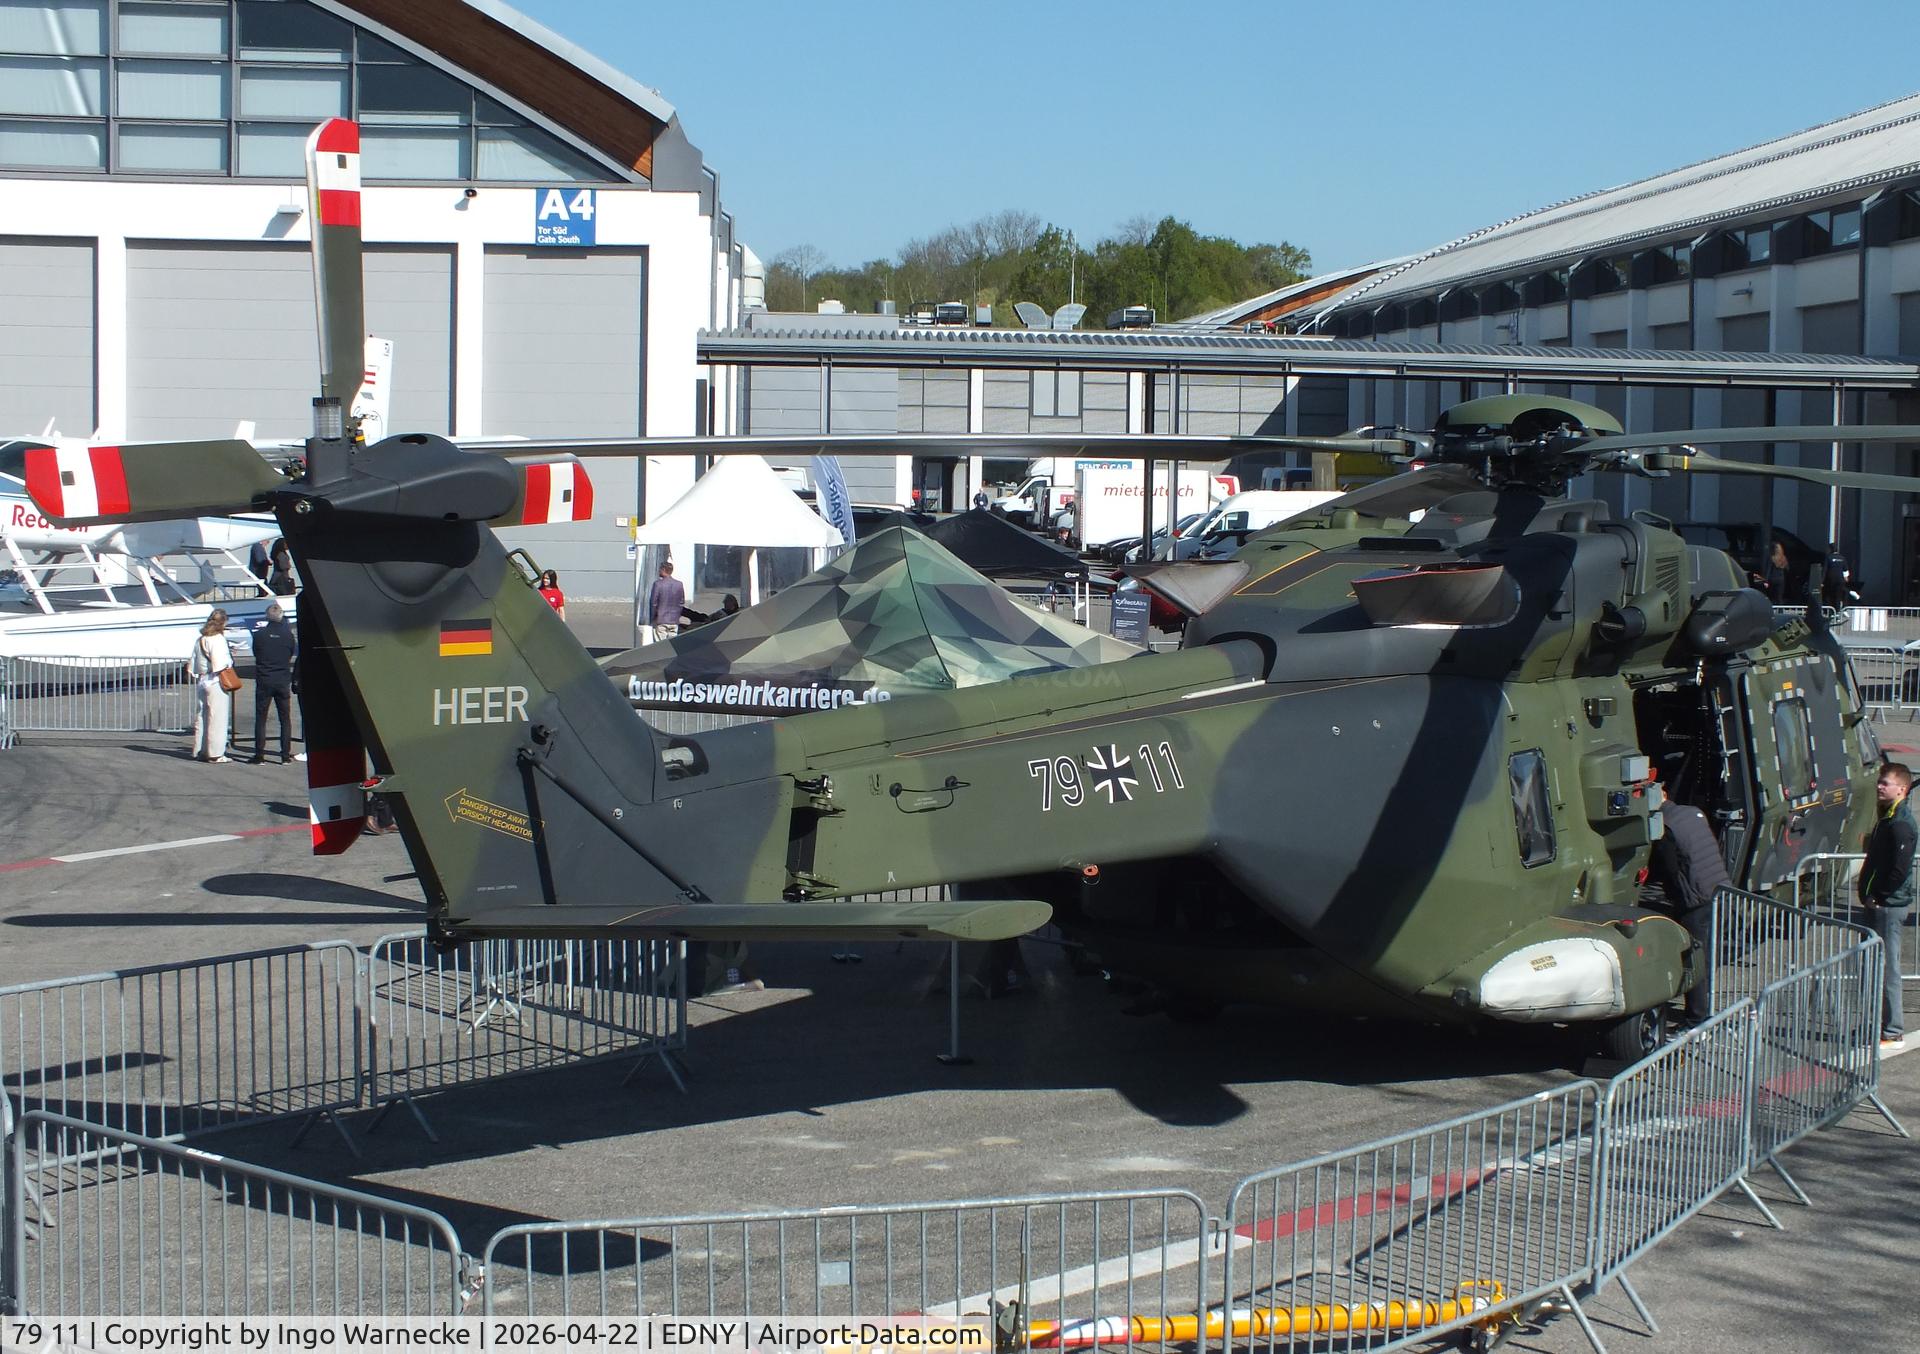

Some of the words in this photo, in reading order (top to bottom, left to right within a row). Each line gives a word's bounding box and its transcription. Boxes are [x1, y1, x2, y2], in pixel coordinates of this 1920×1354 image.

[539, 189, 594, 220] A4
[538, 226, 551, 235] Tor
[553, 226, 567, 235] Süd
[538, 235, 556, 244] Gate
[558, 235, 580, 244] South
[1104, 484, 1194, 497] mietautch
[434, 686, 529, 726] HEER
[628, 675, 891, 710] bundeswehrkarrierede
[1028, 755, 1085, 811] 79
[1138, 741, 1185, 793] 11
[457, 807, 492, 821] VORSICHT
[460, 798, 489, 812] DANGER
[489, 806, 508, 818] KEEP
[508, 815, 528, 825] AWAY
